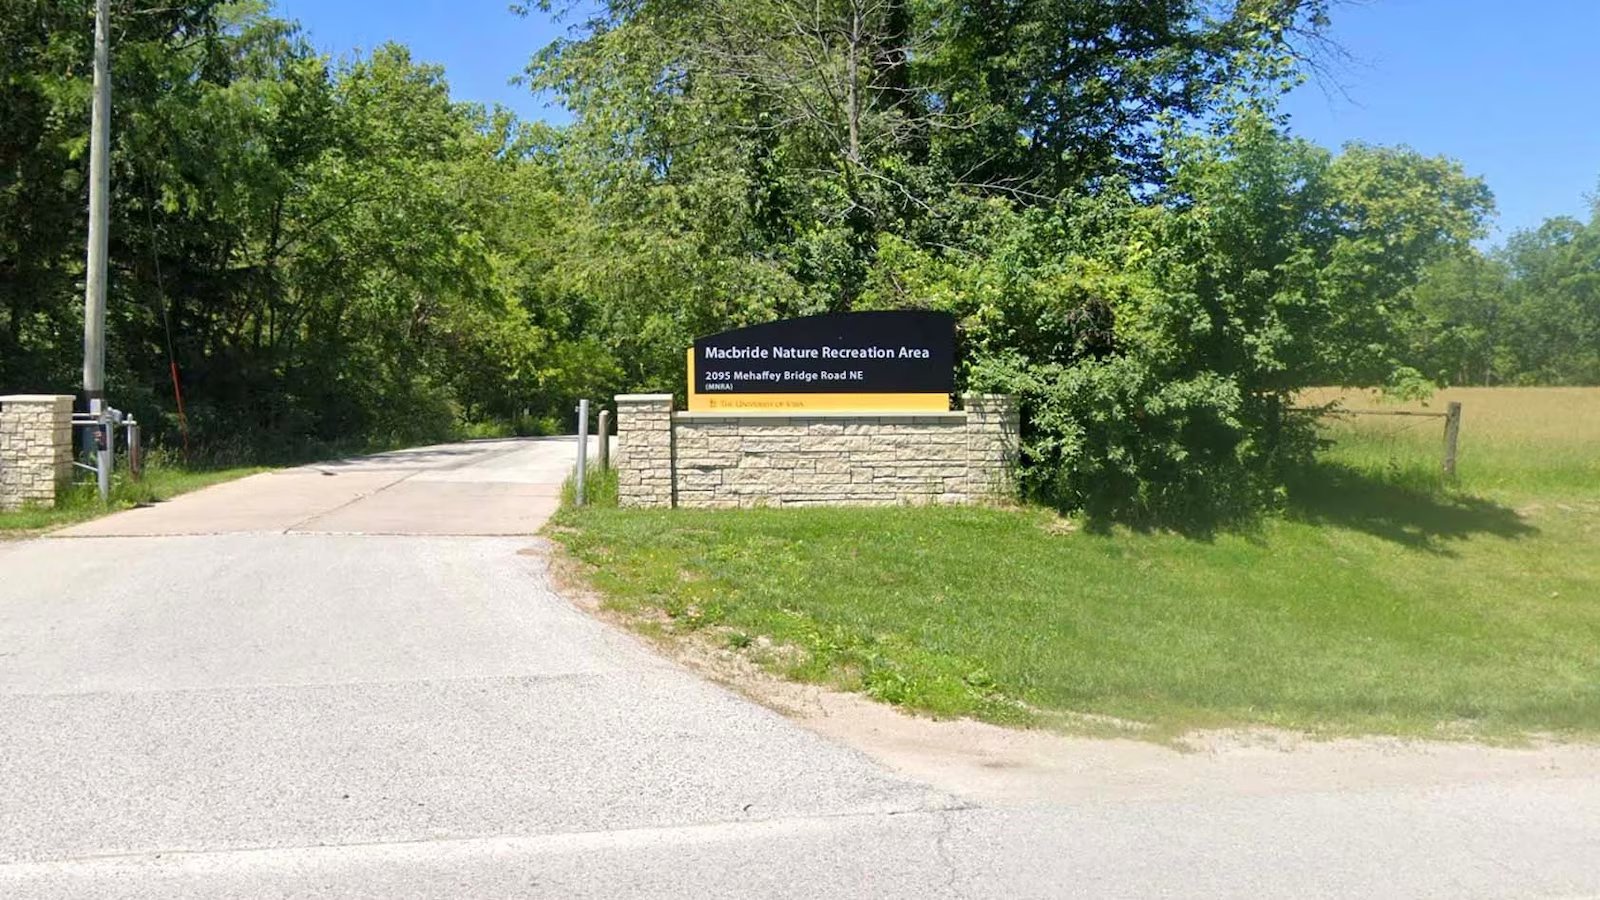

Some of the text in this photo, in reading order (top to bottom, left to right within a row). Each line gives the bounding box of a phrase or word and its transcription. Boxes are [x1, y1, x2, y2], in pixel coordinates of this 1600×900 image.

[705, 346, 930, 359] Macbride Nature Recreation Area
[705, 371, 864, 383] 2095 Mehaffey Bridge Road NE
[705, 383, 734, 391] (MNRA)
